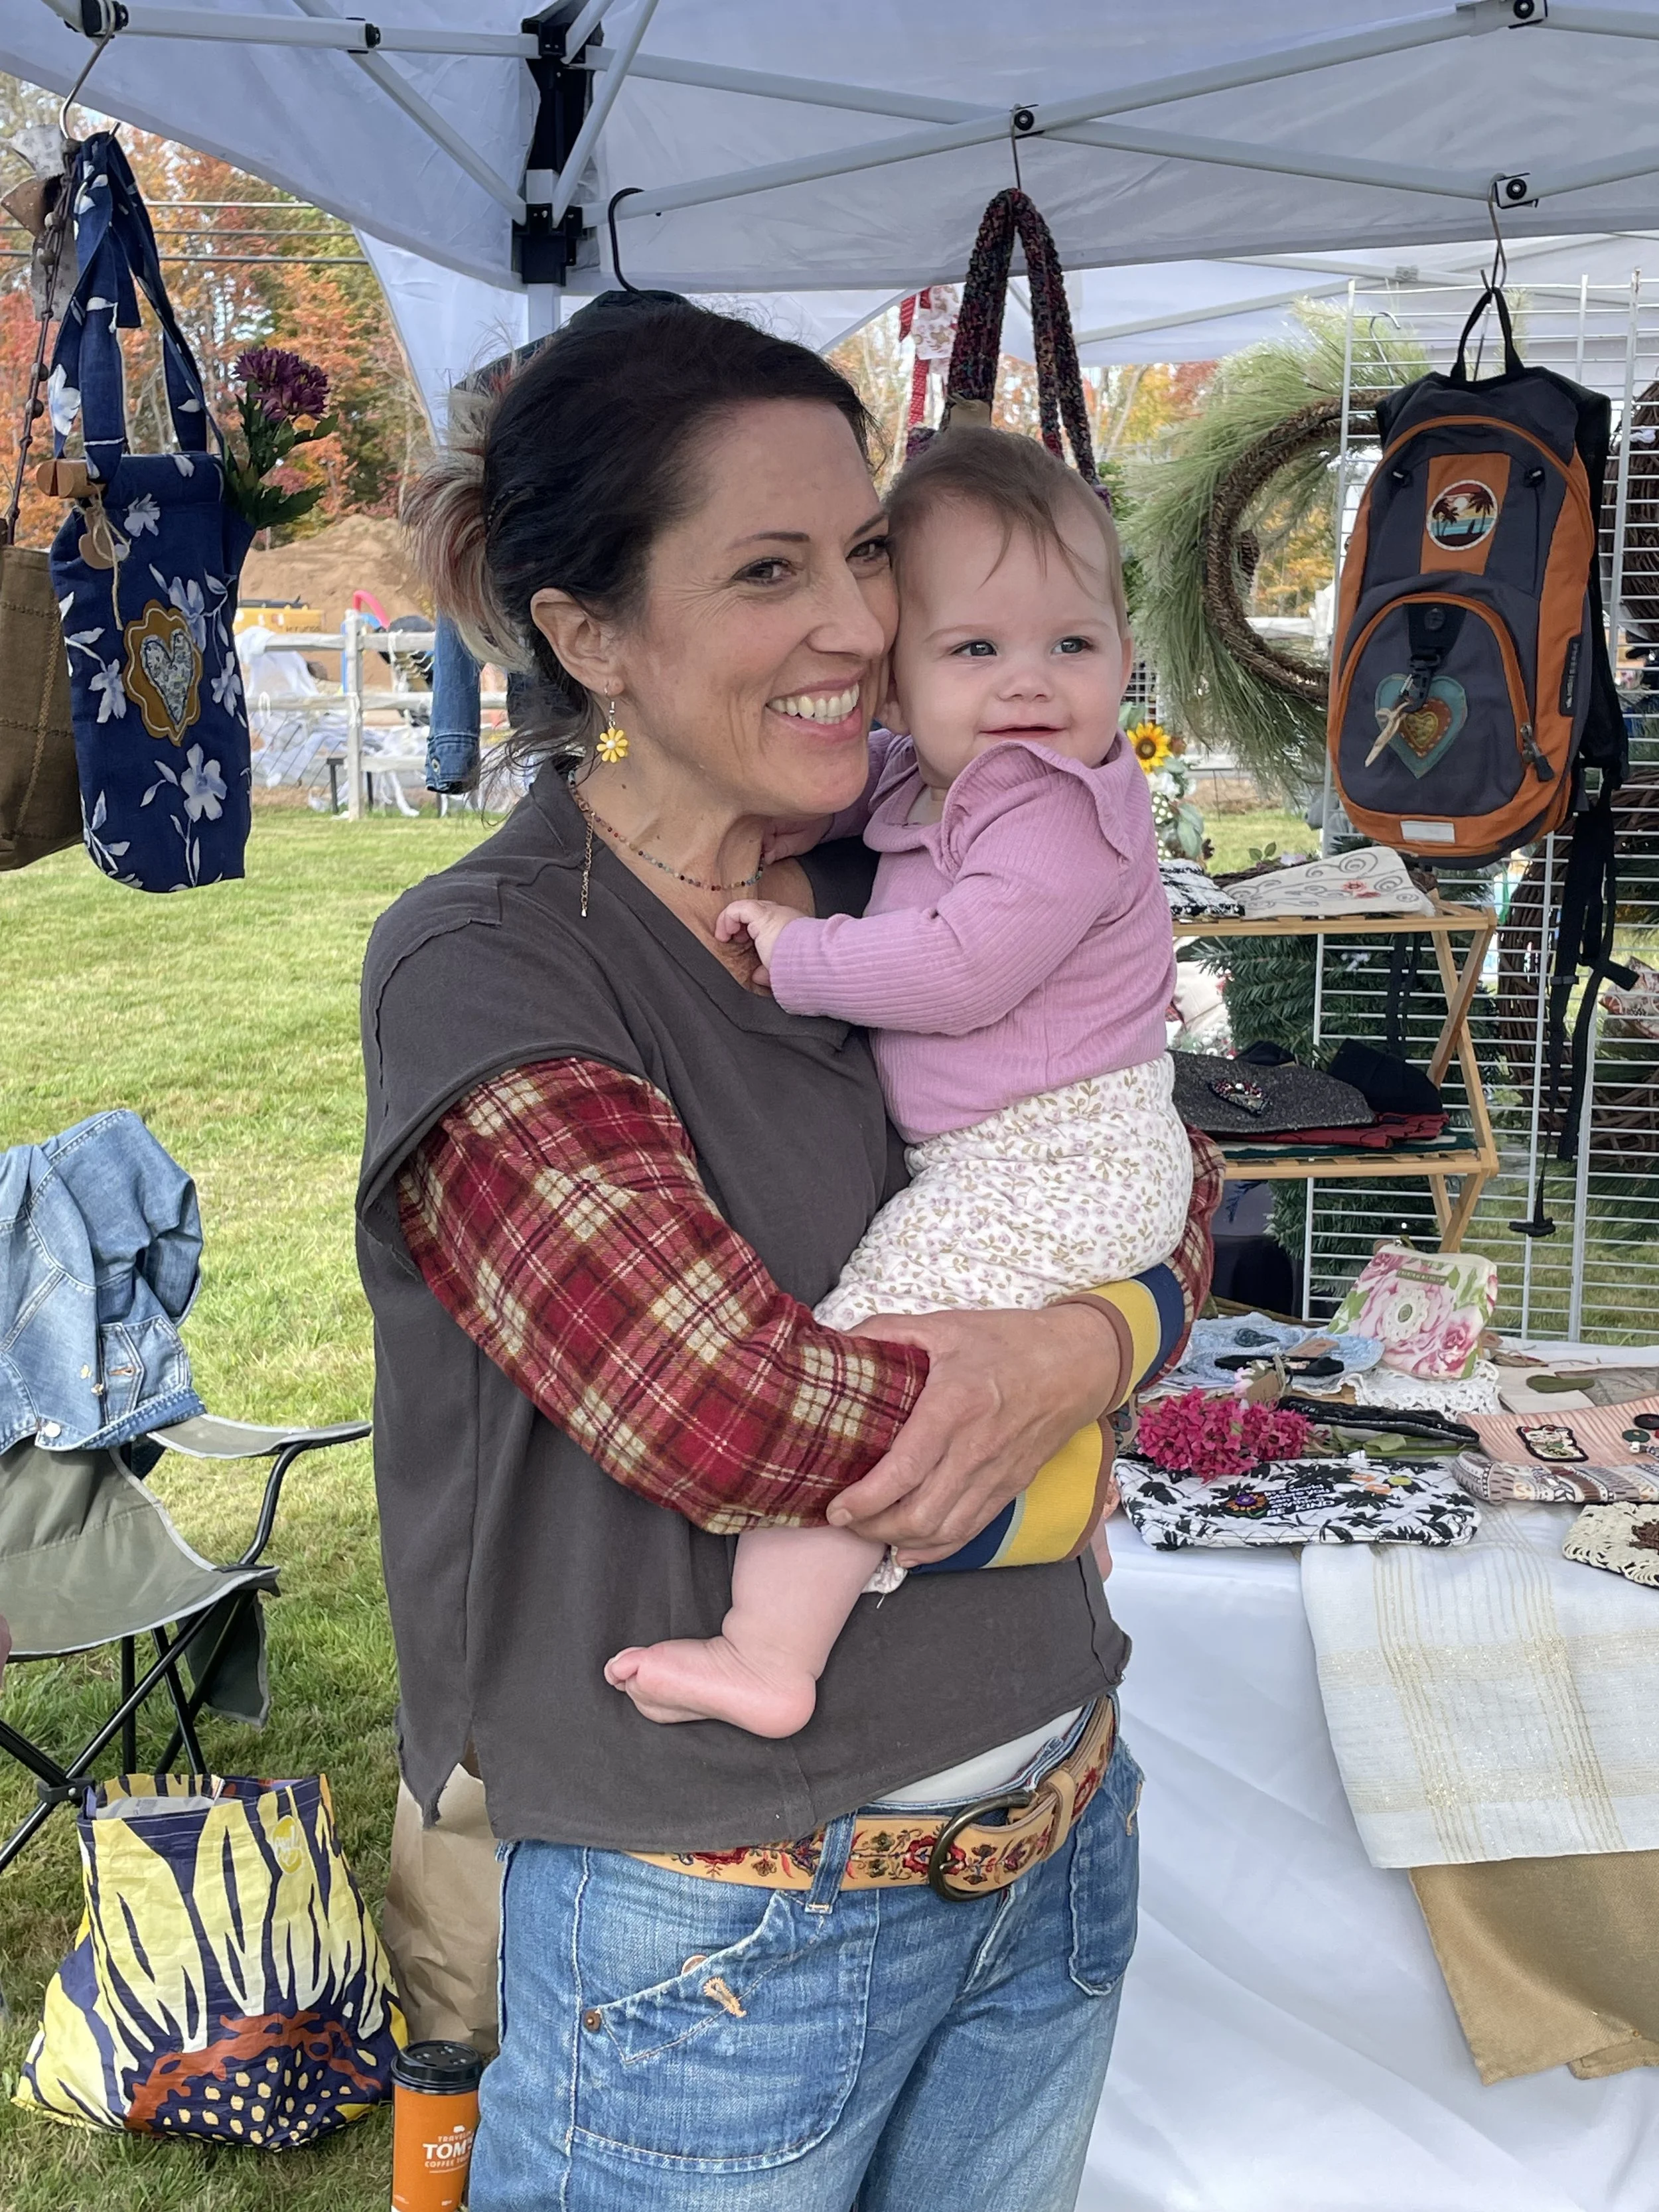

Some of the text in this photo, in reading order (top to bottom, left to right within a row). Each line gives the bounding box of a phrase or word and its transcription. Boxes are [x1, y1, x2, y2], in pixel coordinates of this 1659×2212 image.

[1267, 1500, 1335, 1517] BE KIND
[425, 2158, 455, 2168] COFFEE
